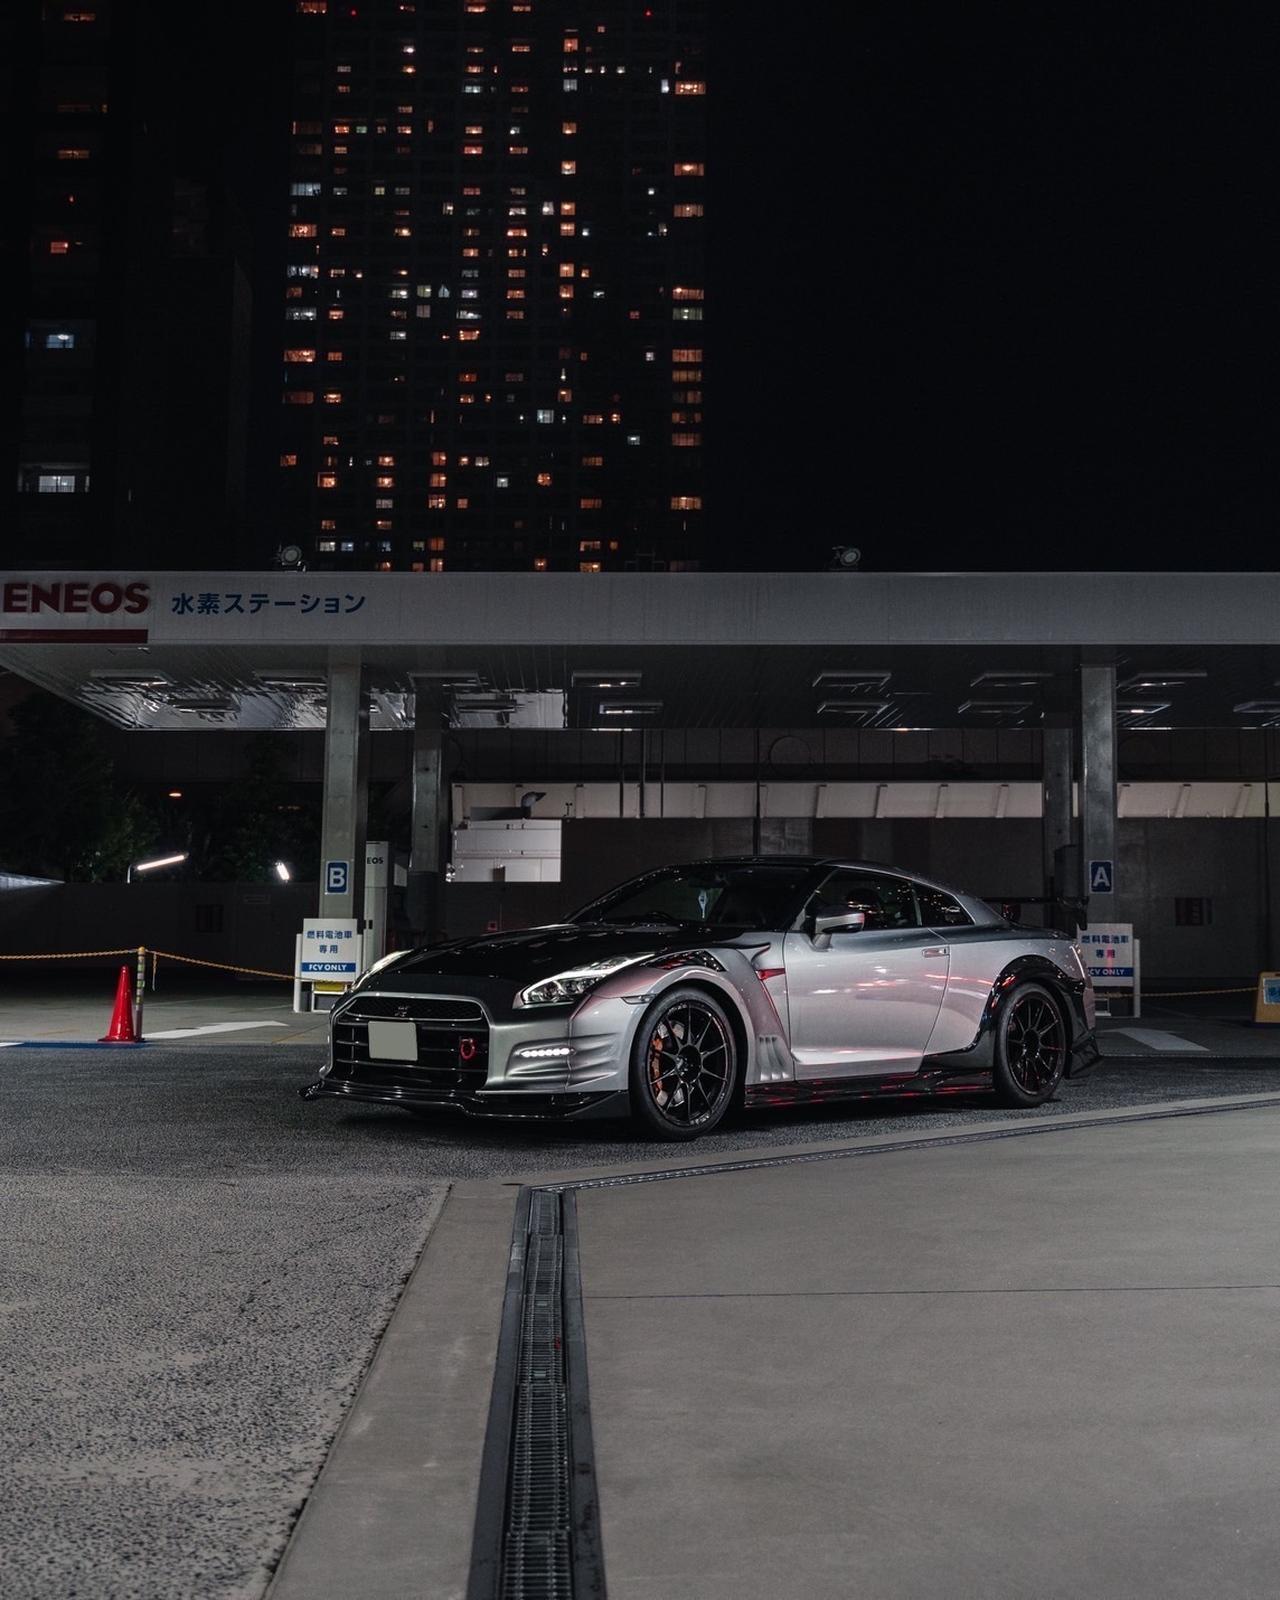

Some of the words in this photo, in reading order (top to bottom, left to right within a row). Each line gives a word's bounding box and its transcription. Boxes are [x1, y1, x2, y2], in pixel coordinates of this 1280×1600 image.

[3, 582, 149, 613] ENEOS
[171, 592, 366, 615] 水素ステーション
[328, 867, 345, 888] B
[1092, 866, 1111, 887] A
[307, 930, 353, 940] 燃料電池車
[308, 963, 324, 971] FCV
[324, 963, 347, 971] ONLY
